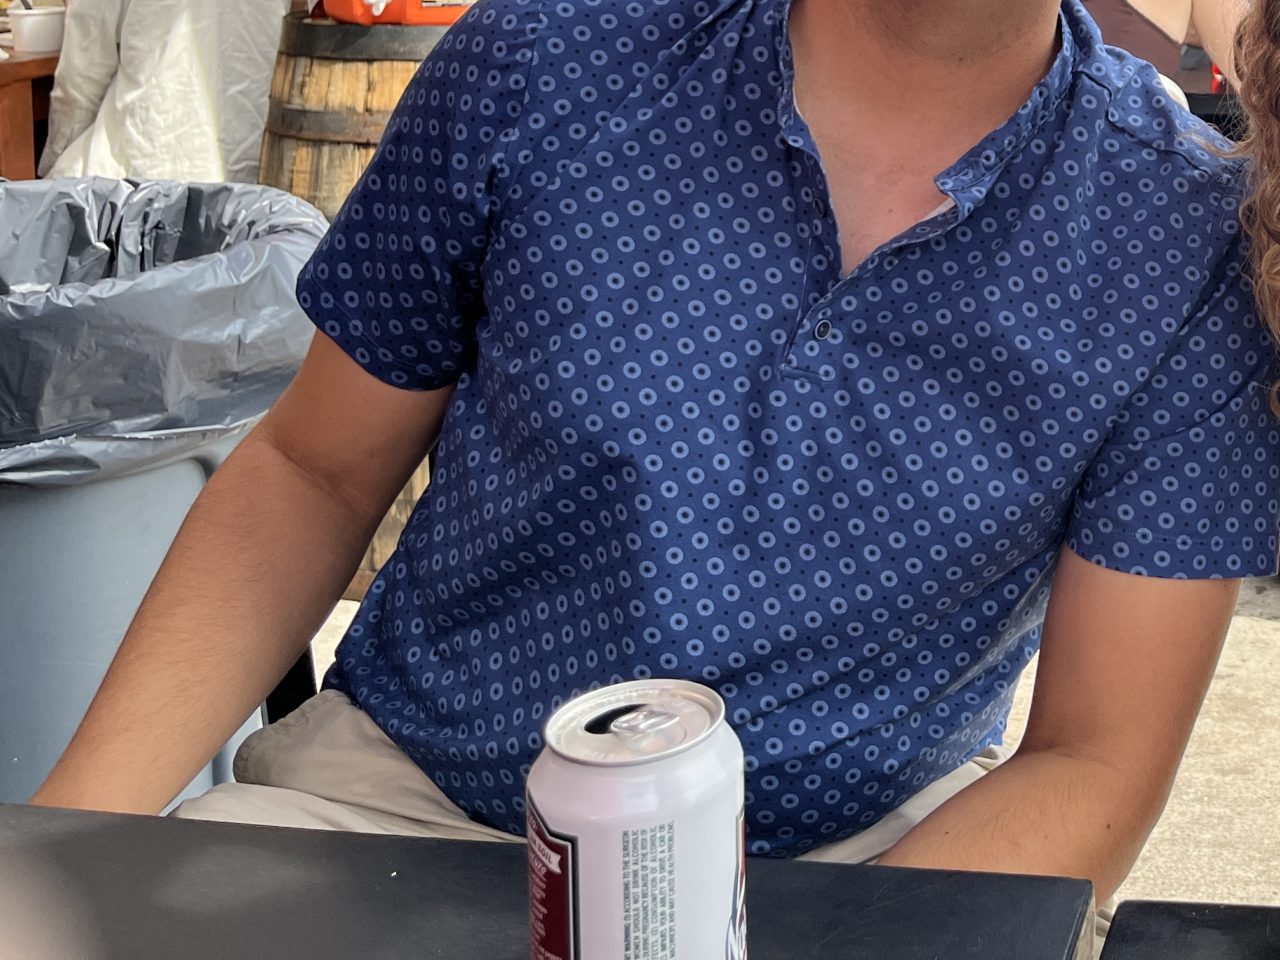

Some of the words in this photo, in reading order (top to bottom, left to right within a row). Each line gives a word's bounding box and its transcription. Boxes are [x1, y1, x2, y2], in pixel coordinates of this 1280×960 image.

[659, 824, 666, 833] OR
[622, 830, 630, 858] SURGEON
[631, 829, 639, 865] ALCOHOLIC
[640, 838, 648, 850] RISK
[622, 860, 630, 870] THE
[623, 871, 630, 879] TO
[659, 875, 666, 884] TO
[650, 877, 658, 924] CONSUMPTION
[659, 886, 667, 907] ABILITY
[632, 907, 640, 933] SHOULD
